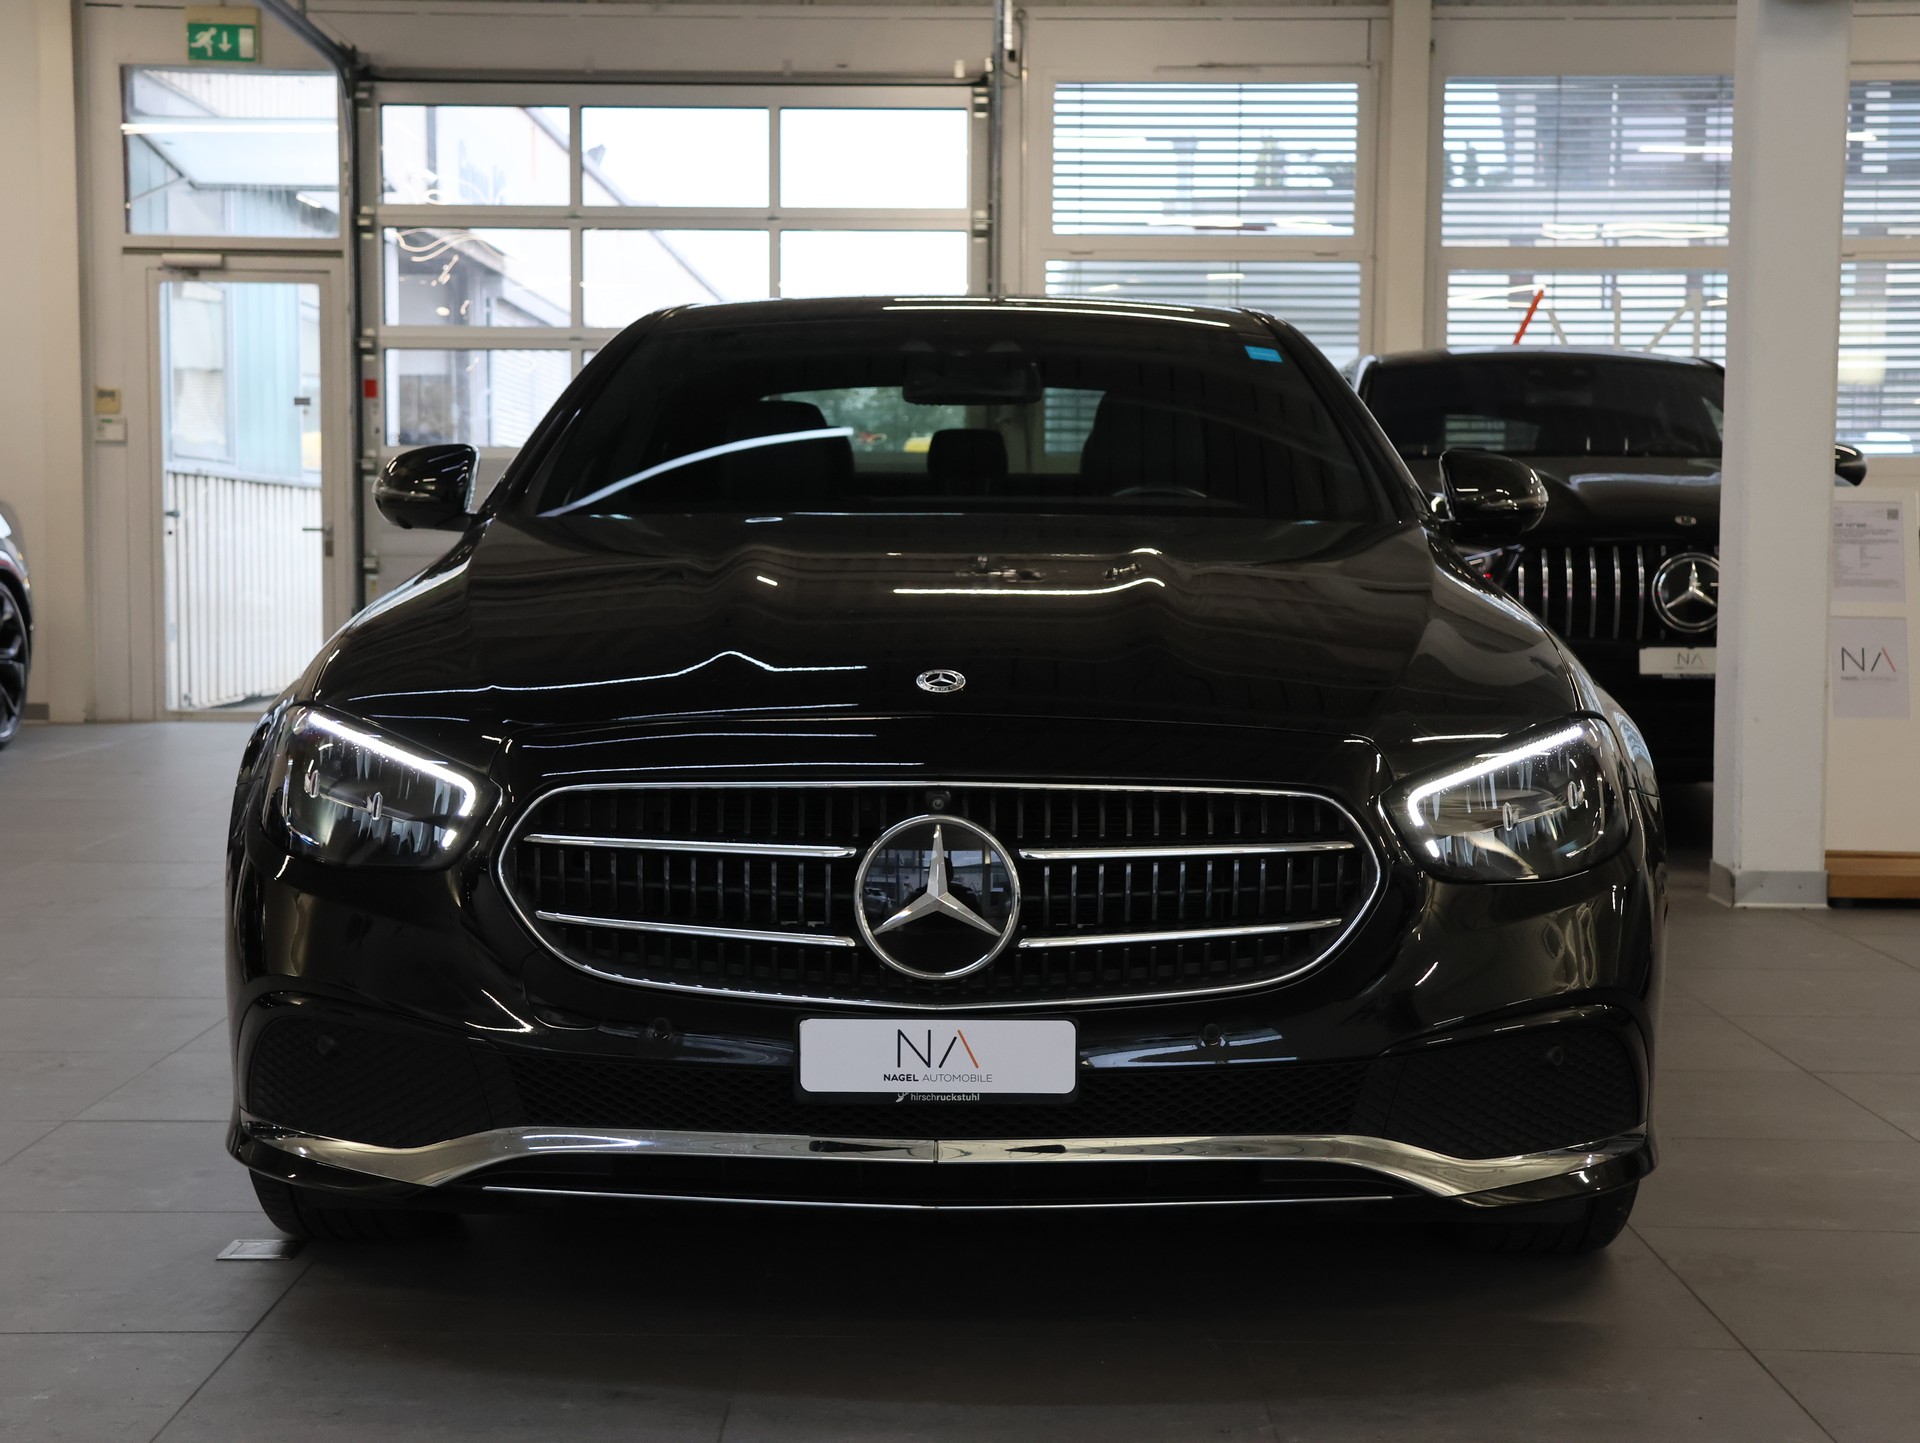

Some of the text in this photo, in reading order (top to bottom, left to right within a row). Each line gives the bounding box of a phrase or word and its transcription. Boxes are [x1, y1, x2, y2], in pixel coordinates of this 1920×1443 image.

[1677, 652, 1704, 666] NA
[1841, 647, 1897, 672] NA
[897, 1029, 979, 1068] NA
[883, 1073, 993, 1083] NAGEL AUTOMOBILE
[910, 1092, 980, 1102] hirschruckstuhl
